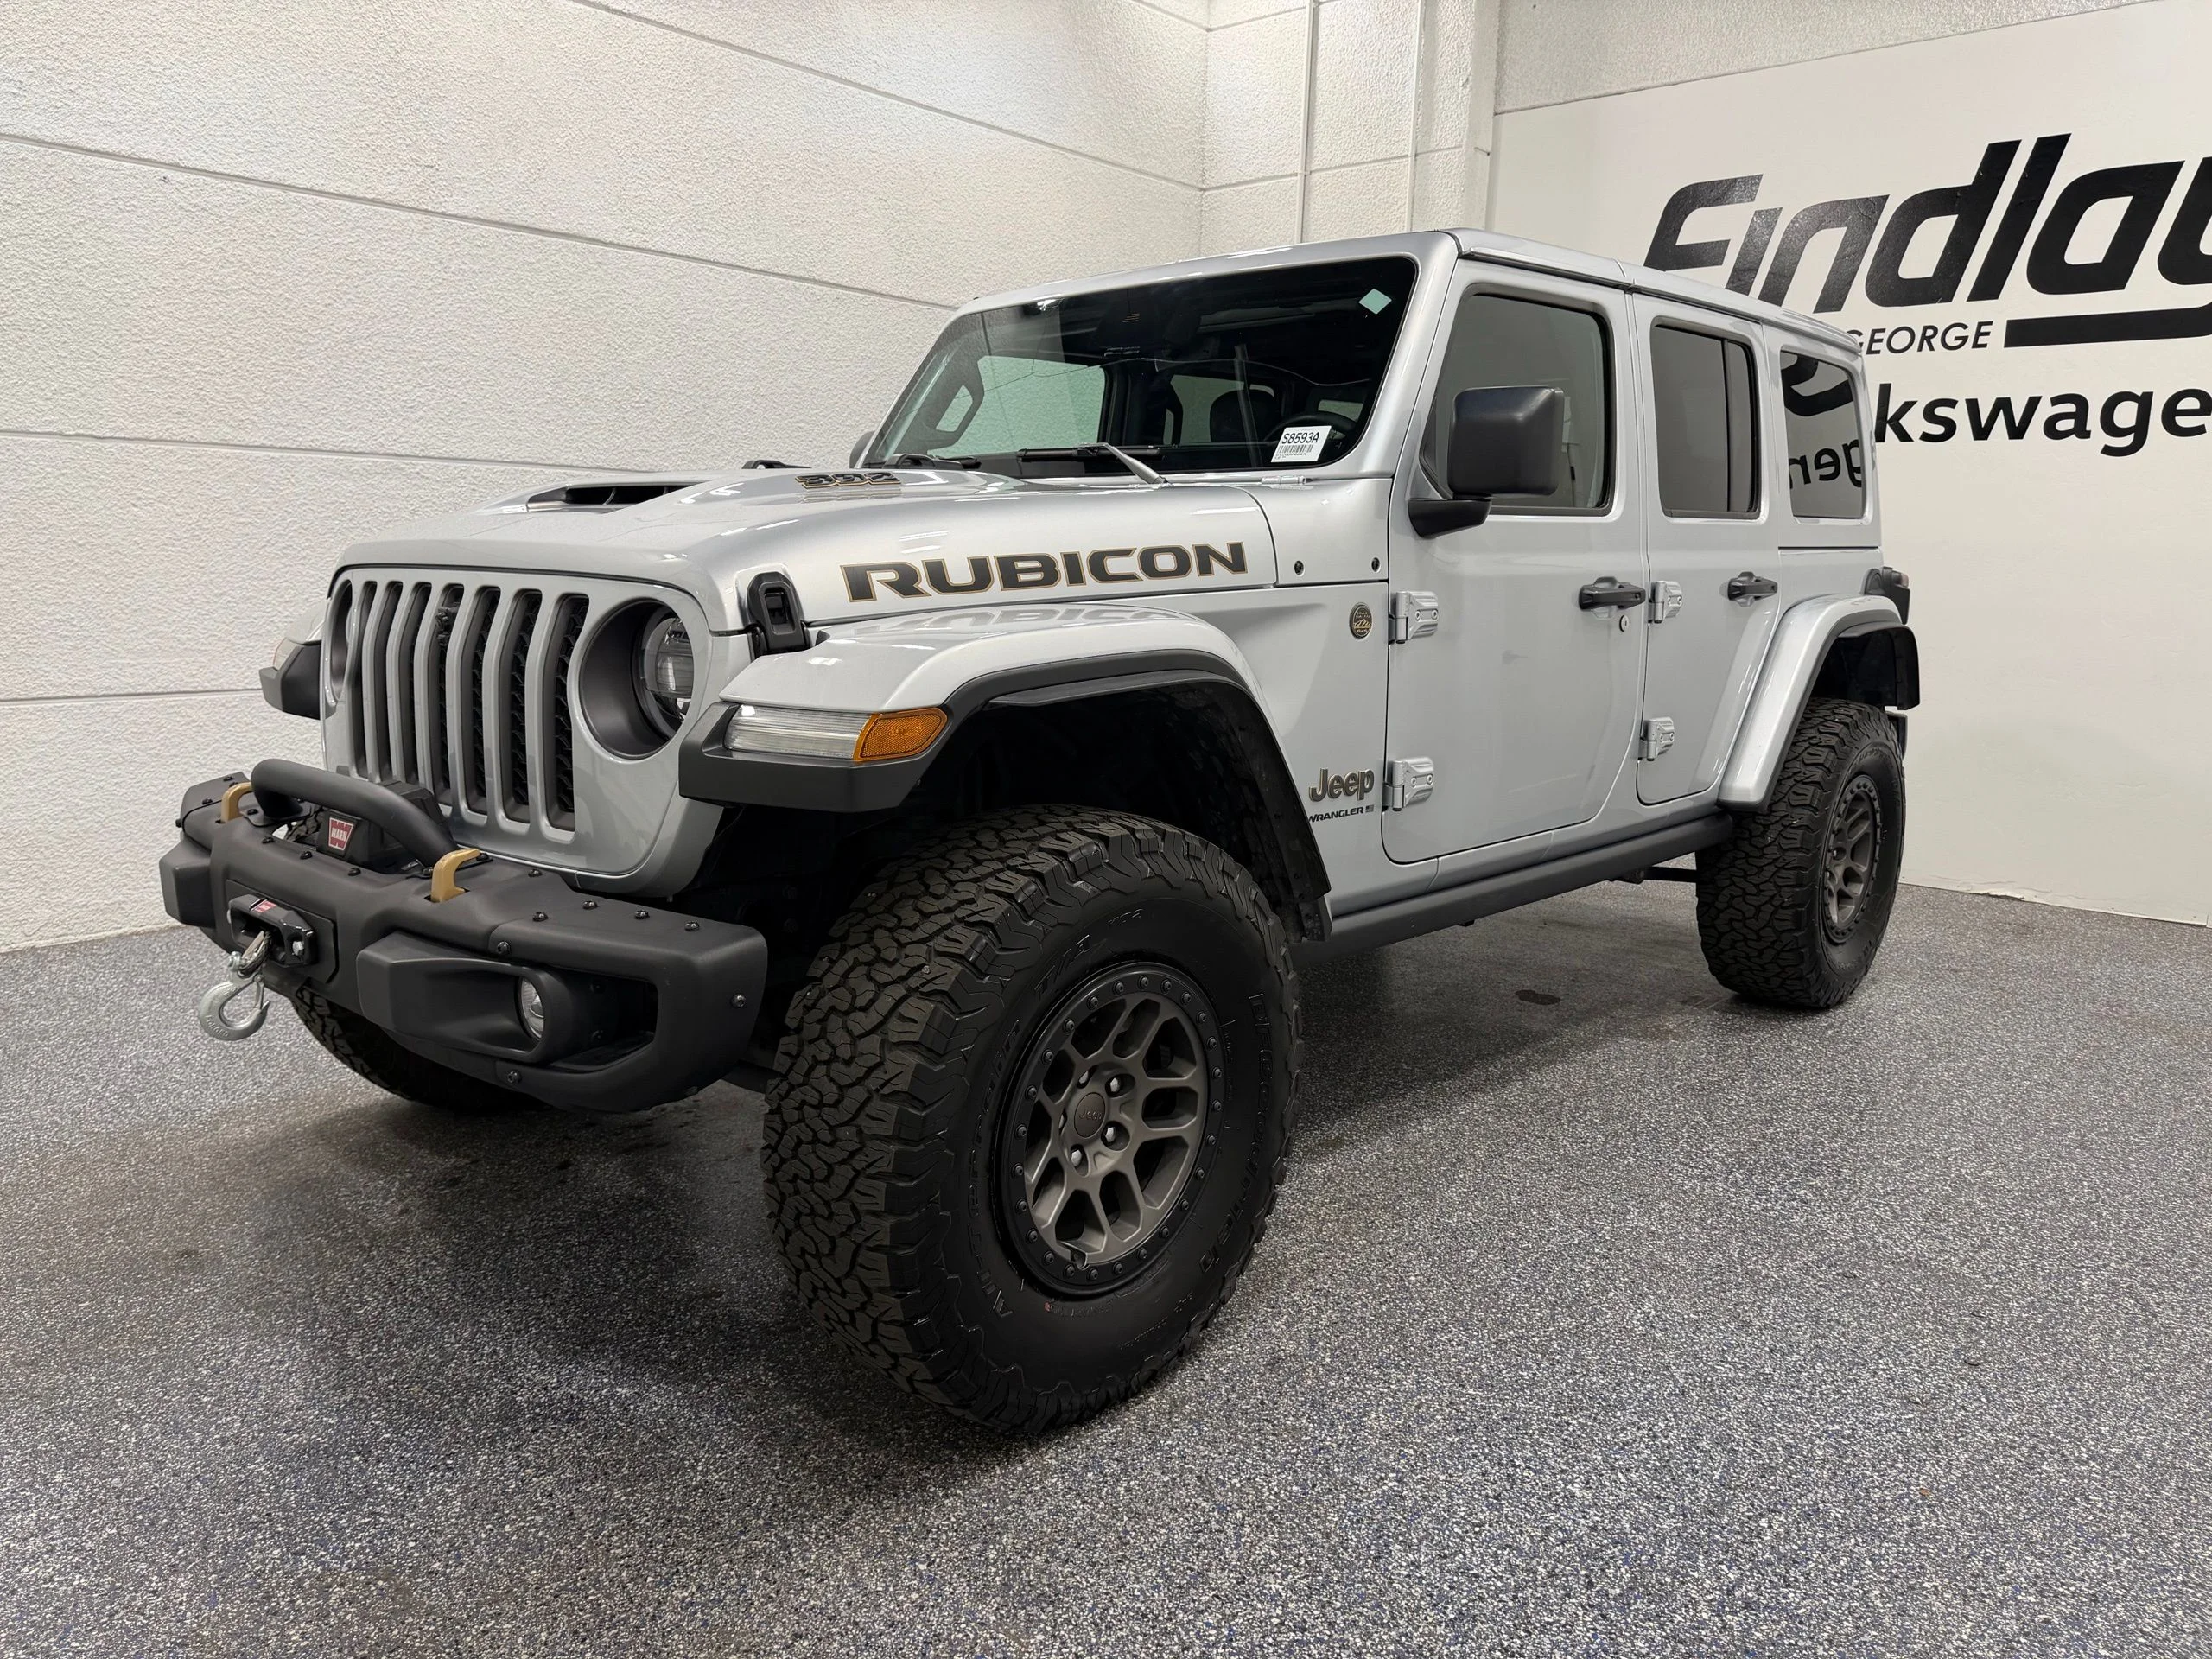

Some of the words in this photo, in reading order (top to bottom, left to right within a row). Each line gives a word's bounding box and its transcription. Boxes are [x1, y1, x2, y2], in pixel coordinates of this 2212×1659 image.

[1281, 432, 1319, 444] S8593A
[840, 542, 1248, 602] RUBICON
[1309, 768, 1374, 802] Jeep
[1309, 806, 1364, 823] WRANGLER
[331, 827, 347, 842] WARN
